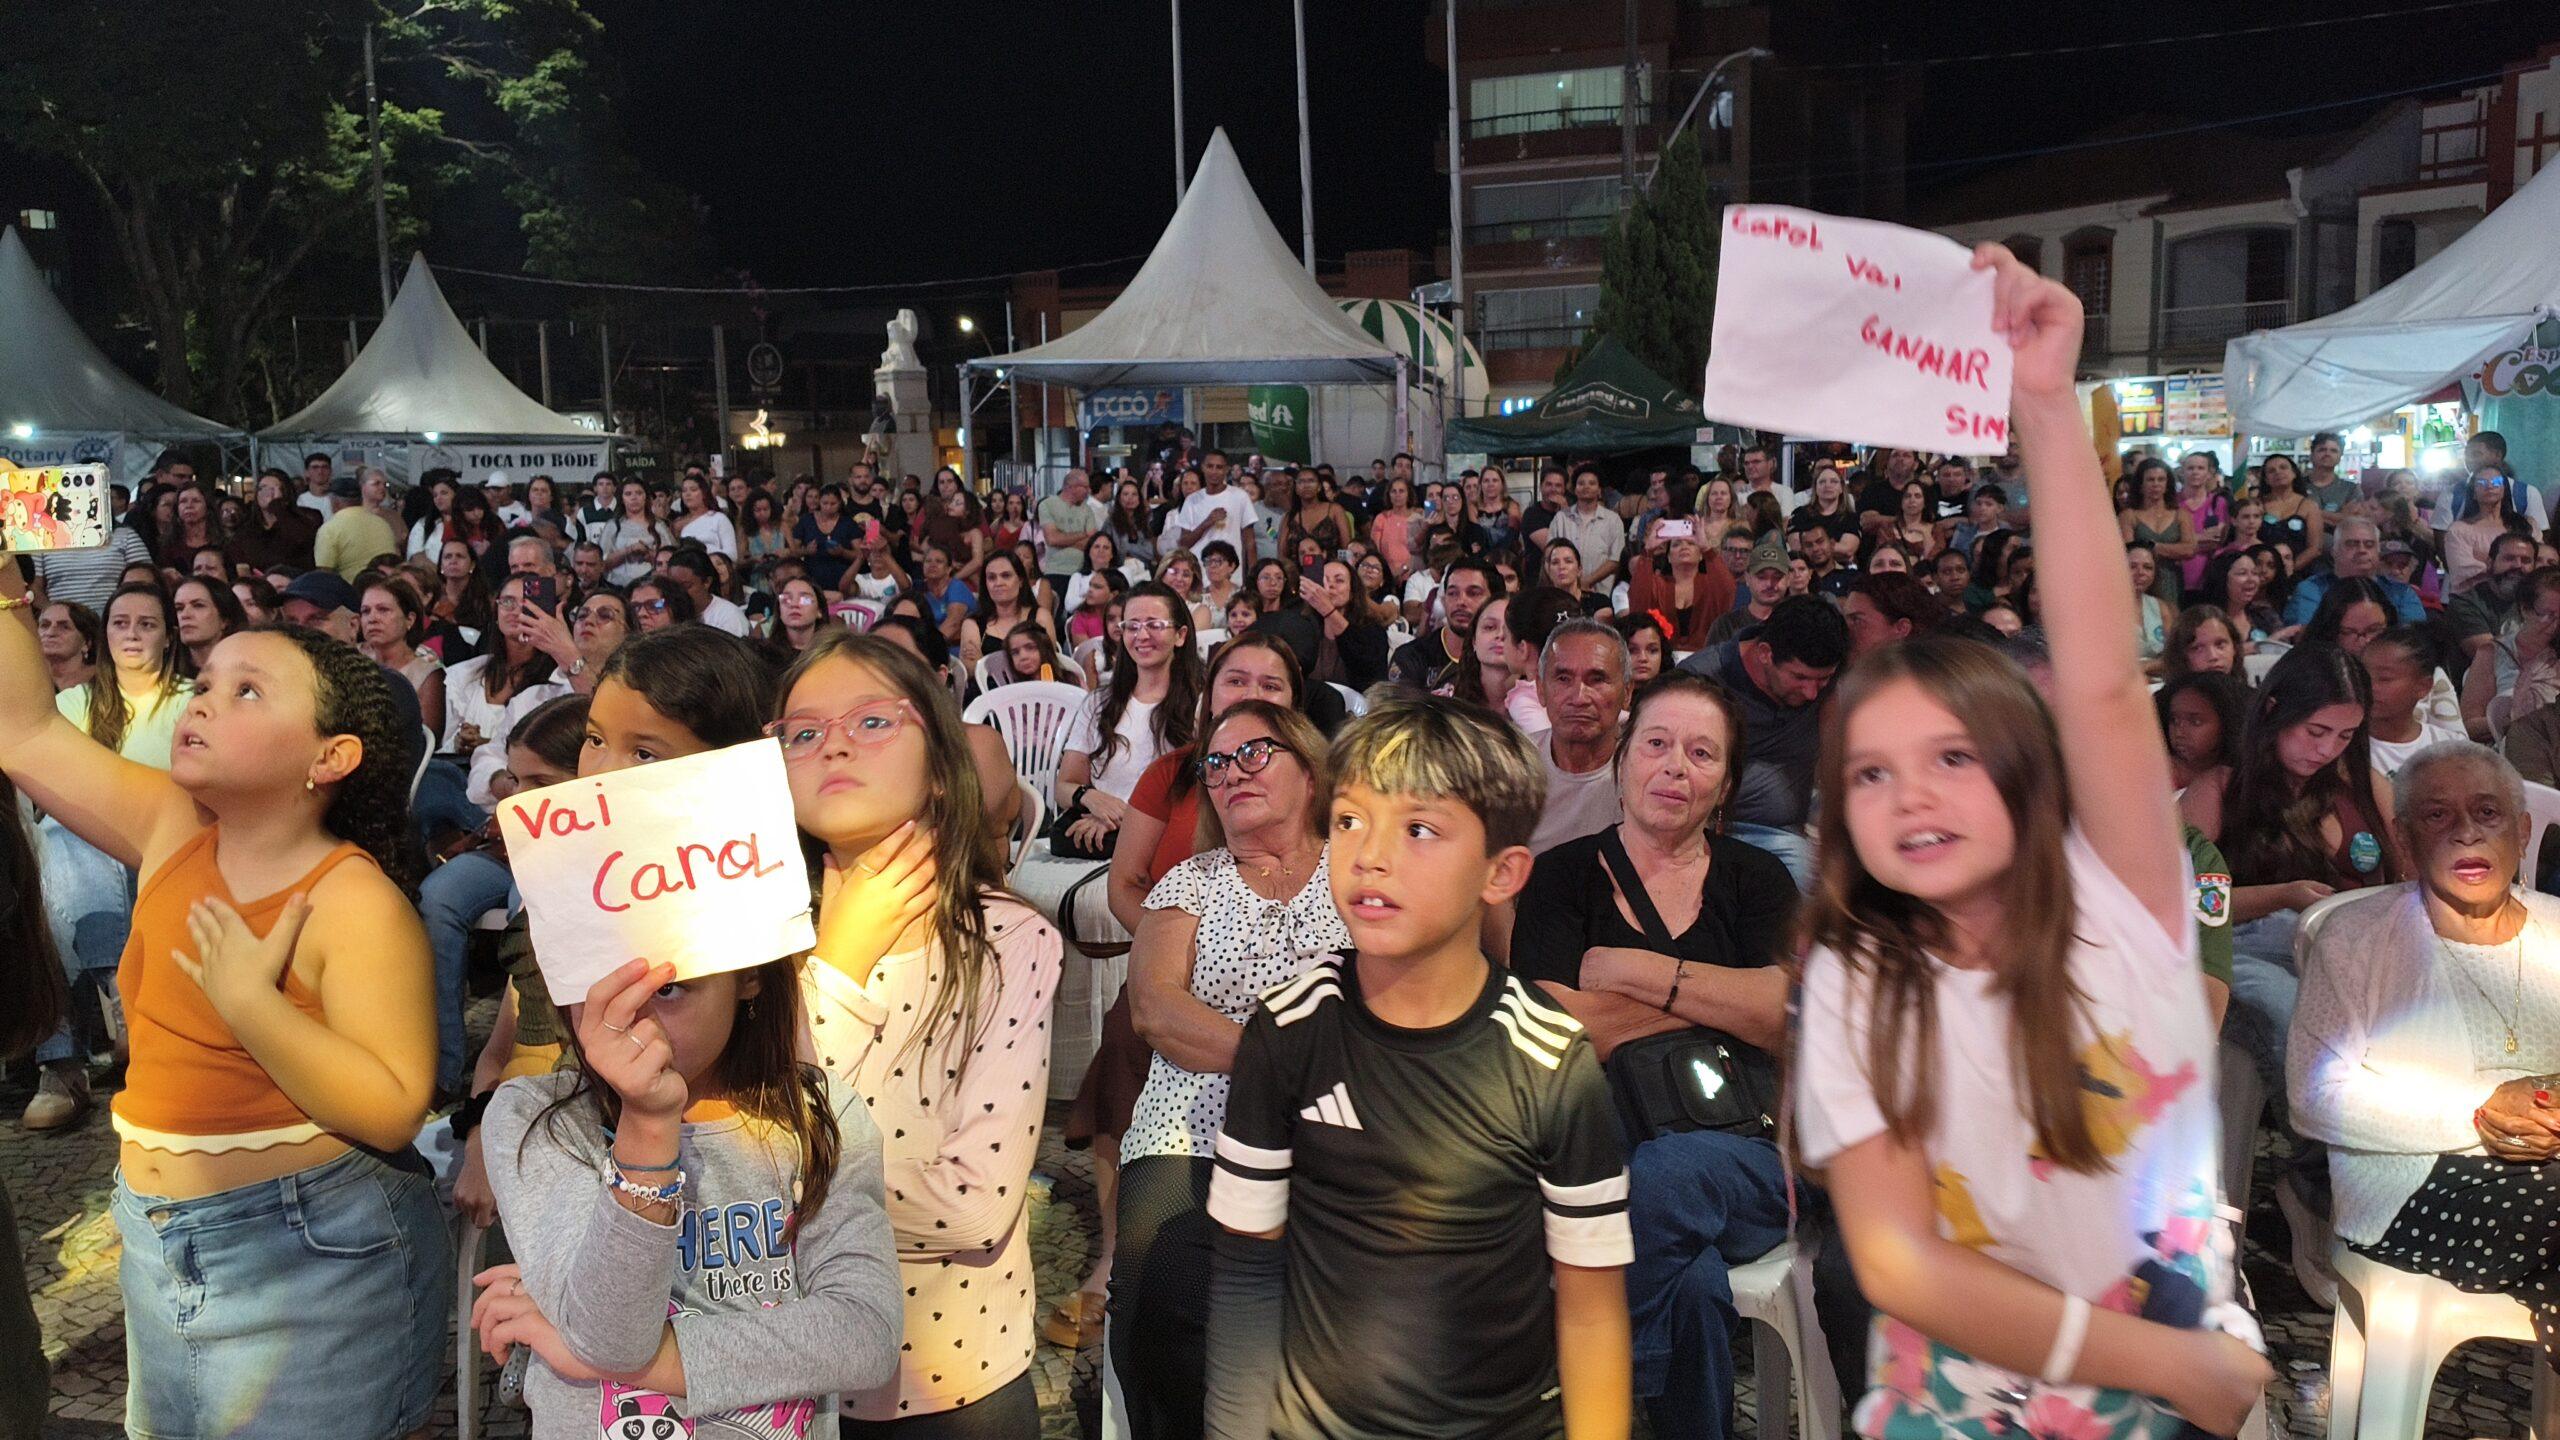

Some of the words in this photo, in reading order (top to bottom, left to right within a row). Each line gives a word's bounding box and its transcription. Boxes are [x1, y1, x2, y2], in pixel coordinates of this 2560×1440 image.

[468, 453, 514, 468] TOCA
[520, 453, 545, 468] DO
[551, 452, 598, 468] BODE
[512, 782, 611, 839] Vai
[705, 1271, 764, 1302] there
[772, 1267, 792, 1291] is
